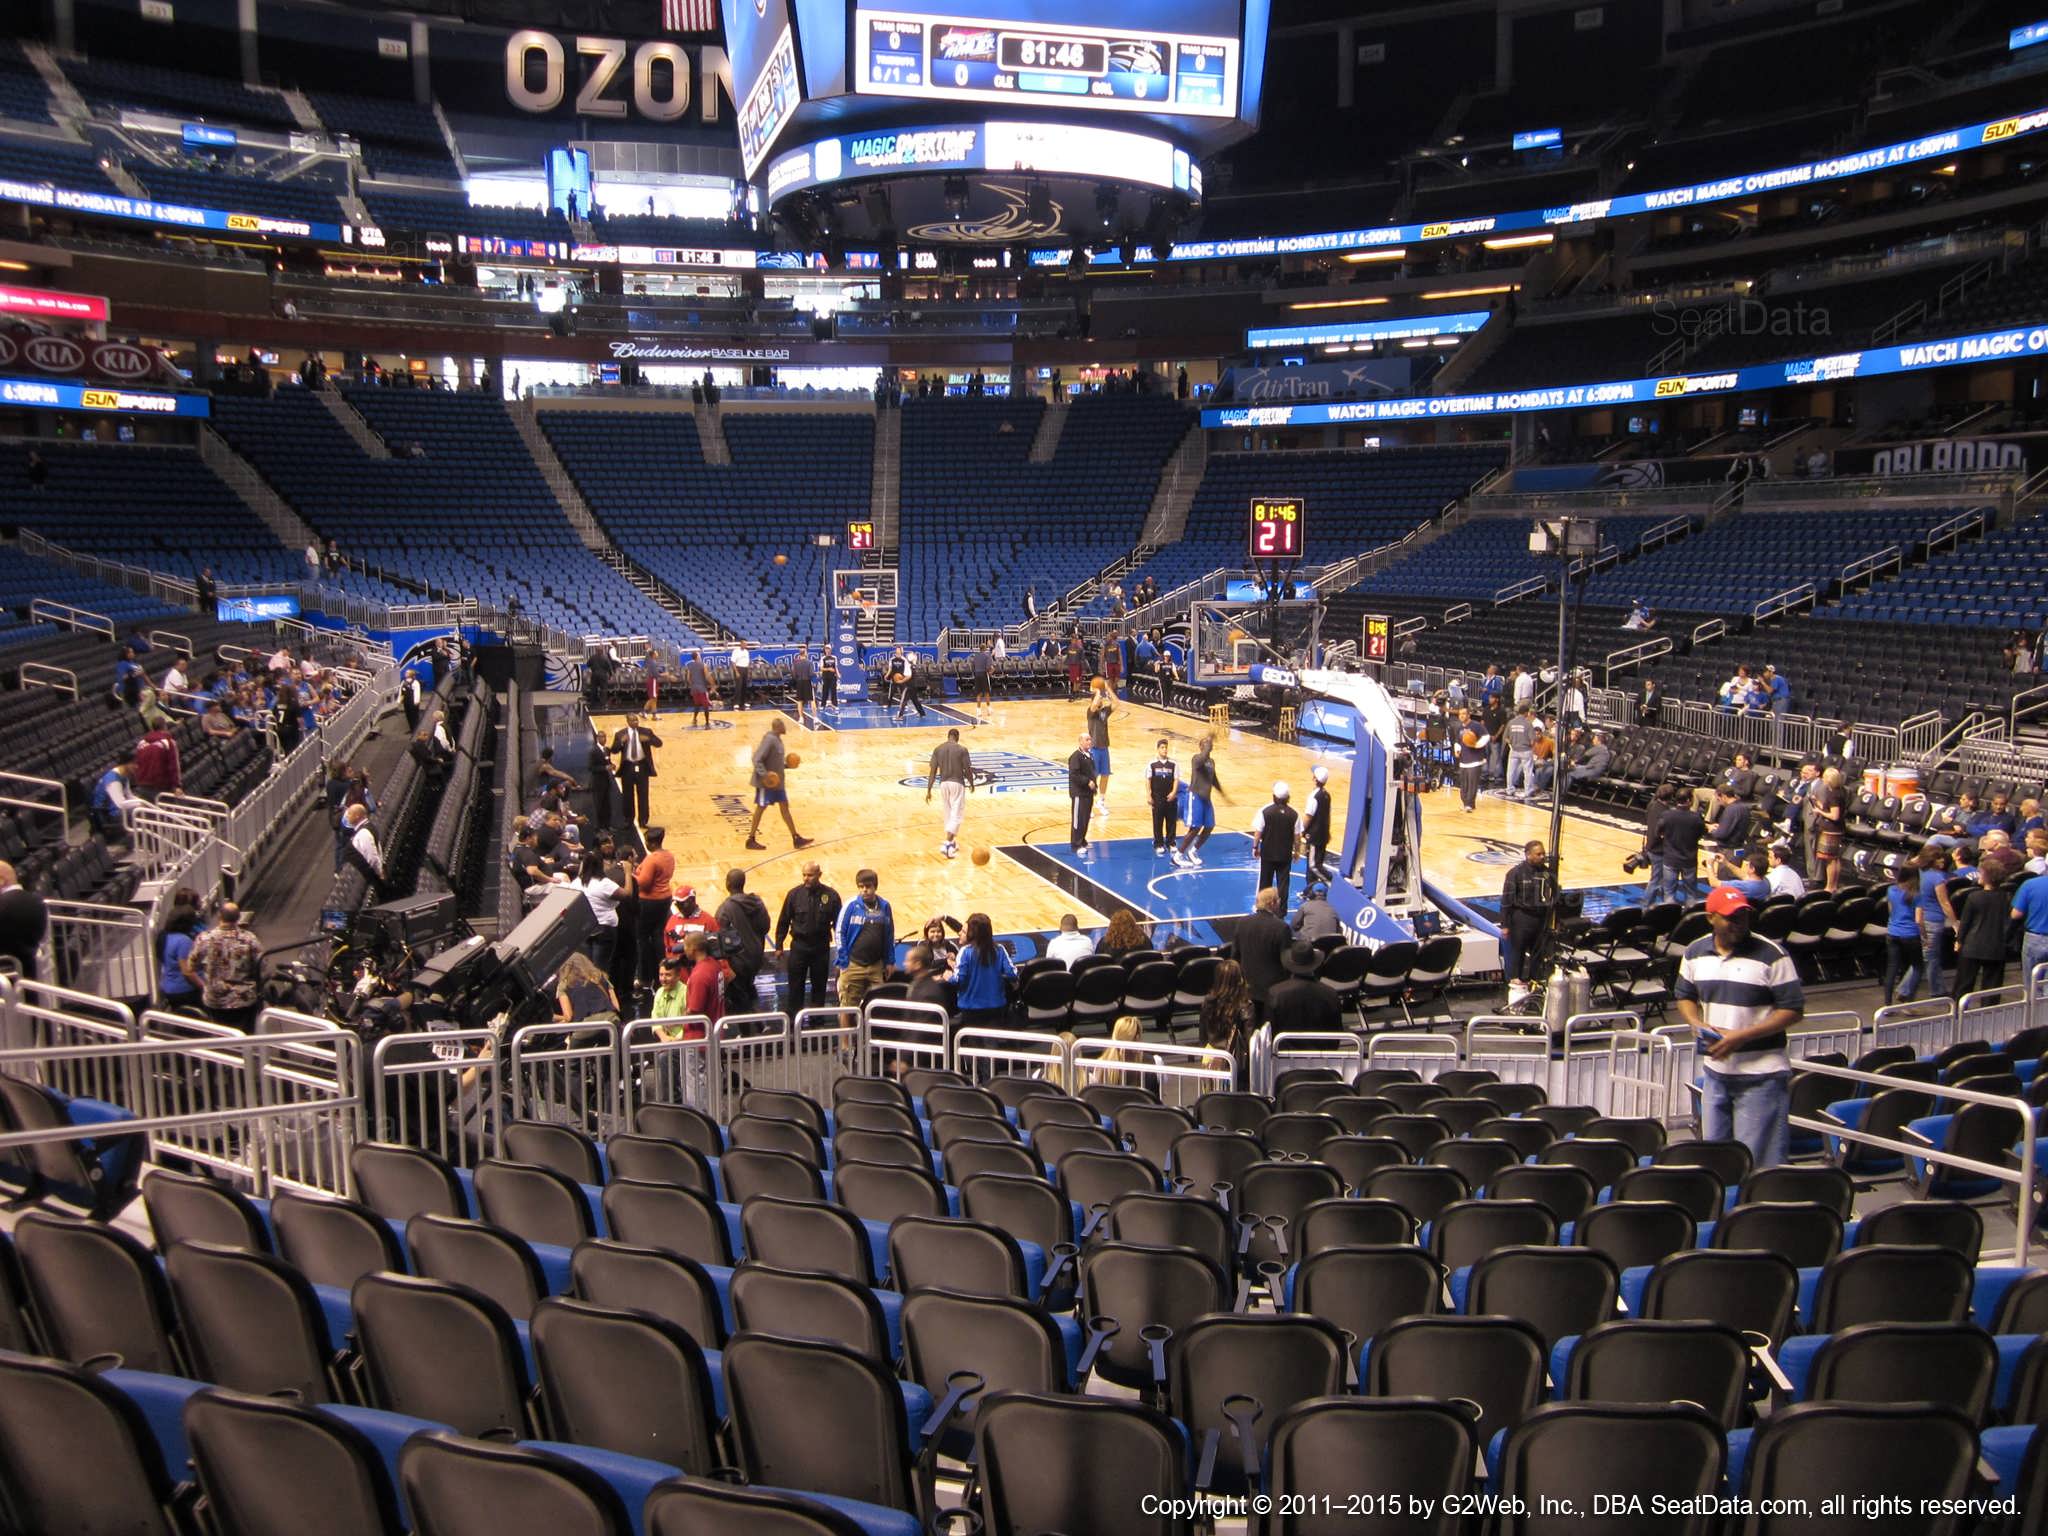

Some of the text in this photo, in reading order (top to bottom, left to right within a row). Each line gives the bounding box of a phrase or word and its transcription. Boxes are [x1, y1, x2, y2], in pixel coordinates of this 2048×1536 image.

[1021, 43, 1084, 68] 81:46
[1984, 121, 2017, 140] SUN
[851, 136, 896, 158] MAGIC
[1645, 135, 1958, 208] WATCH MAGIC OVERTIME MONDAYS AT 6:00PM
[58, 191, 132, 213] MONDAYS
[135, 203, 152, 216] AT
[230, 216, 258, 230] SUN
[1543, 208, 1570, 220] MAGIC
[1422, 223, 1449, 237] SUN
[1172, 243, 1214, 258] MAGIC
[1217, 239, 1275, 256] OVERTIME
[1277, 235, 1338, 252] MONDAYS
[1341, 233, 1356, 247] AT
[34, 343, 76, 364] KIA
[609, 342, 711, 358] Budweiser
[765, 349, 789, 360] BAR
[1900, 343, 1957, 366] WATCH
[1961, 334, 2024, 359] MAGIC
[103, 352, 142, 372] KIA
[1785, 361, 1814, 377] MAGIC
[1656, 380, 1687, 395] SUN
[84, 391, 118, 407] SUN
[1328, 384, 1633, 420] WATCH MAGIC OVERTIME MONDAYS AT 6:00PM
[1220, 410, 1248, 421] MAGIC
[1255, 504, 1296, 521] 81:46
[853, 532, 870, 547] 21
[1260, 522, 1291, 550] 21
[1370, 636, 1386, 655] 21
